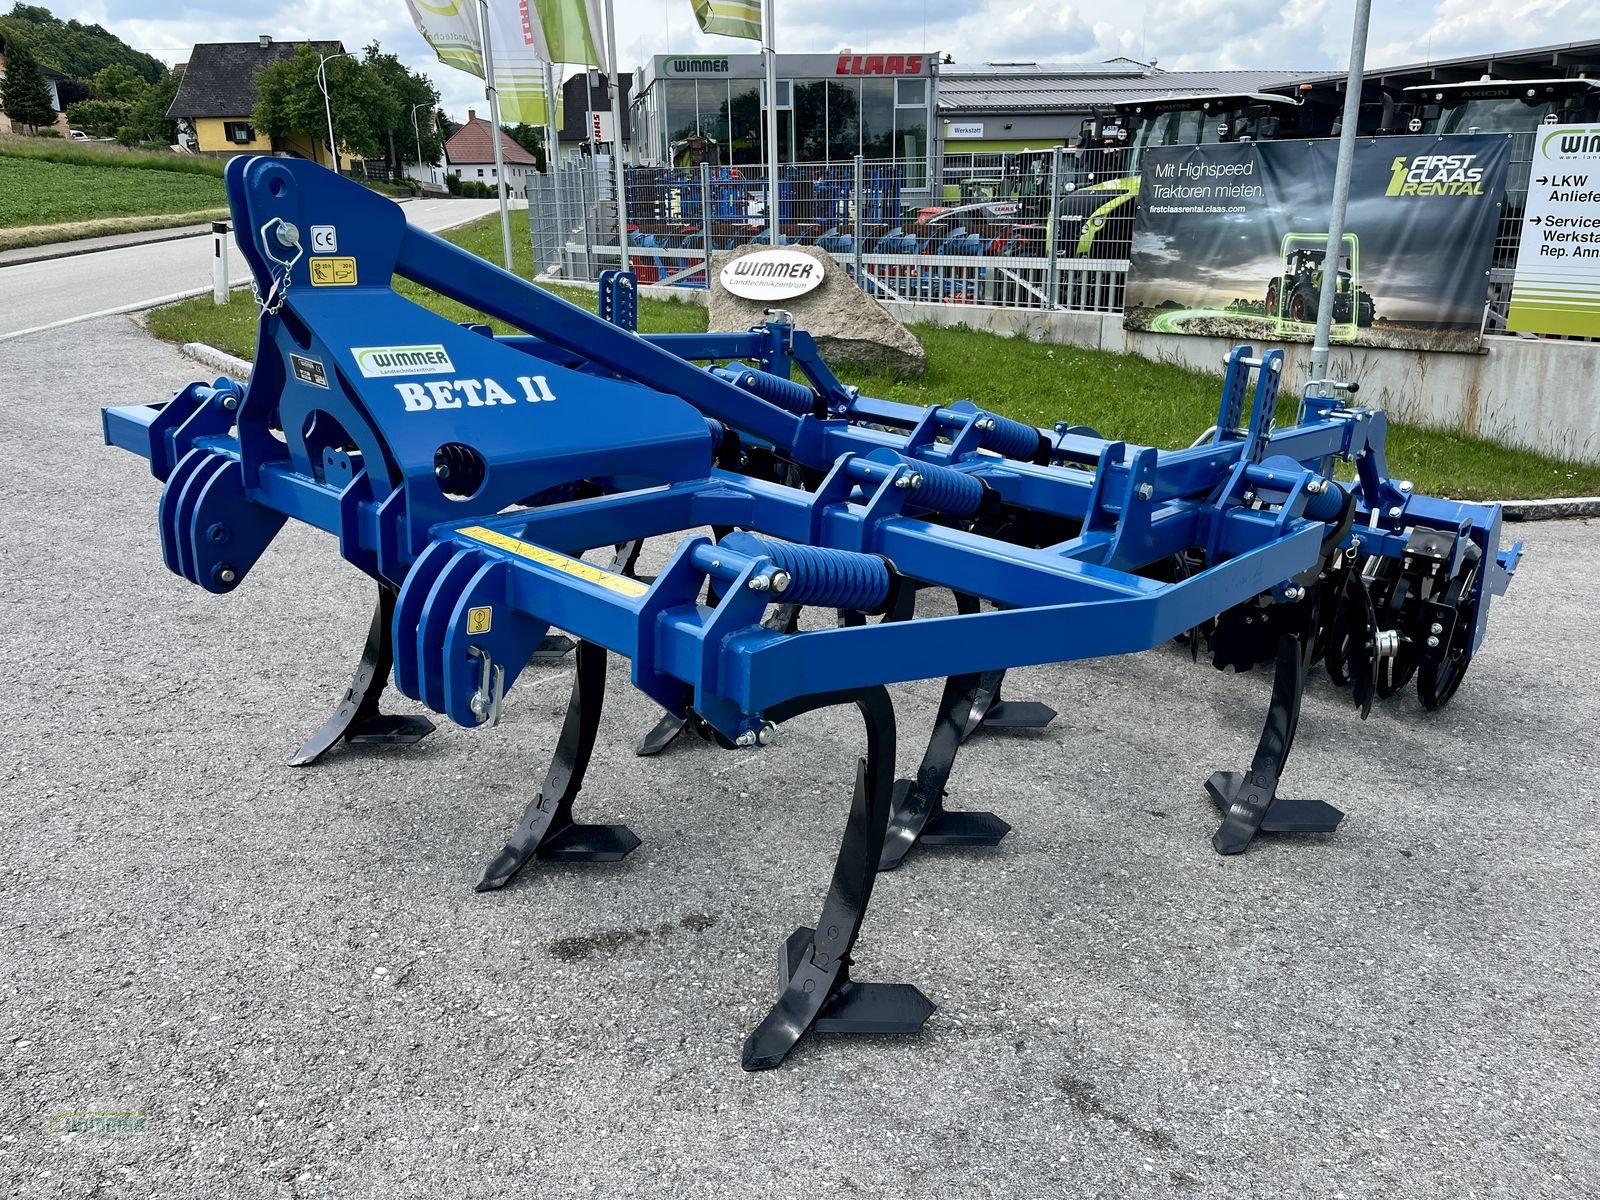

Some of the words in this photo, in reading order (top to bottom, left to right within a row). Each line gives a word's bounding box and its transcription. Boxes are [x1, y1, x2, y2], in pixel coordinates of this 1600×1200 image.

[674, 59, 729, 73] WIMMER
[836, 55, 922, 75] CLAAS
[1461, 89, 1510, 97] AXION
[1411, 155, 1477, 169] FIRST
[1155, 163, 1175, 178] Mit
[1178, 160, 1254, 180] Highspeed
[1406, 168, 1484, 182] CLAAS
[1551, 175, 1588, 187] LKW
[1153, 184, 1211, 199] Traktoren
[1215, 182, 1265, 198] mieten.
[1400, 182, 1484, 196] RENTAL
[1149, 205, 1246, 213] firstclaasrental.claas.com
[1544, 215, 1600, 228] Service
[1540, 245, 1568, 258] Rep.
[734, 261, 814, 279] WIMMER
[729, 279, 807, 289] Landtechnikzentrum
[372, 350, 449, 368] WIMMER
[379, 366, 437, 375] Landtechnikzentrum
[394, 378, 516, 412] BETA
[516, 376, 556, 403] II
